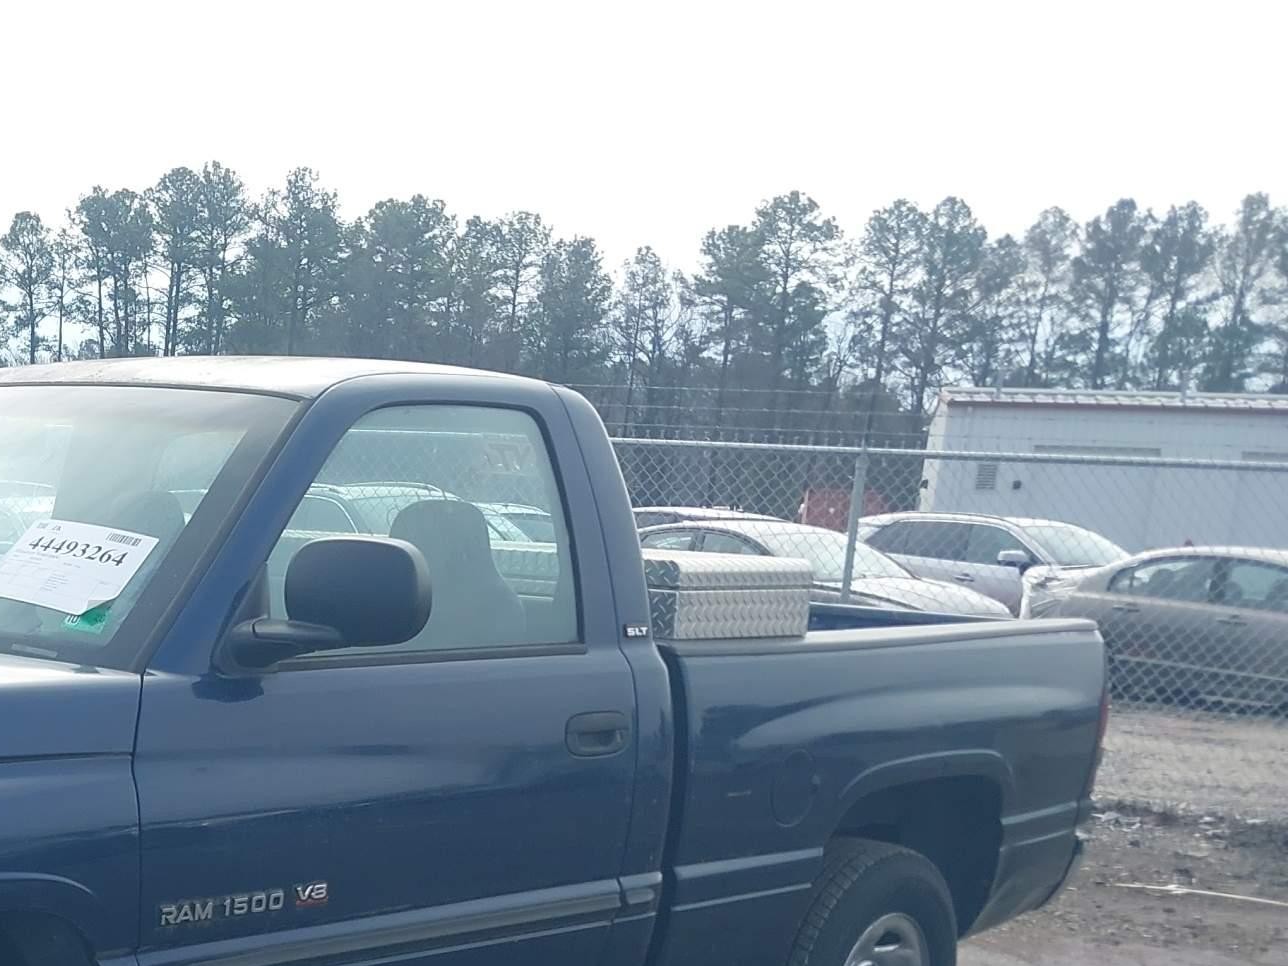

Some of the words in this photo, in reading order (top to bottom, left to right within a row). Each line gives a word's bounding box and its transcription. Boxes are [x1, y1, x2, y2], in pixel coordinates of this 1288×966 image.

[29, 536, 128, 566] 44493264
[626, 627, 648, 636] SLT
[161, 902, 213, 926] RAM
[223, 890, 284, 917] 1500
[296, 882, 328, 901] V8
